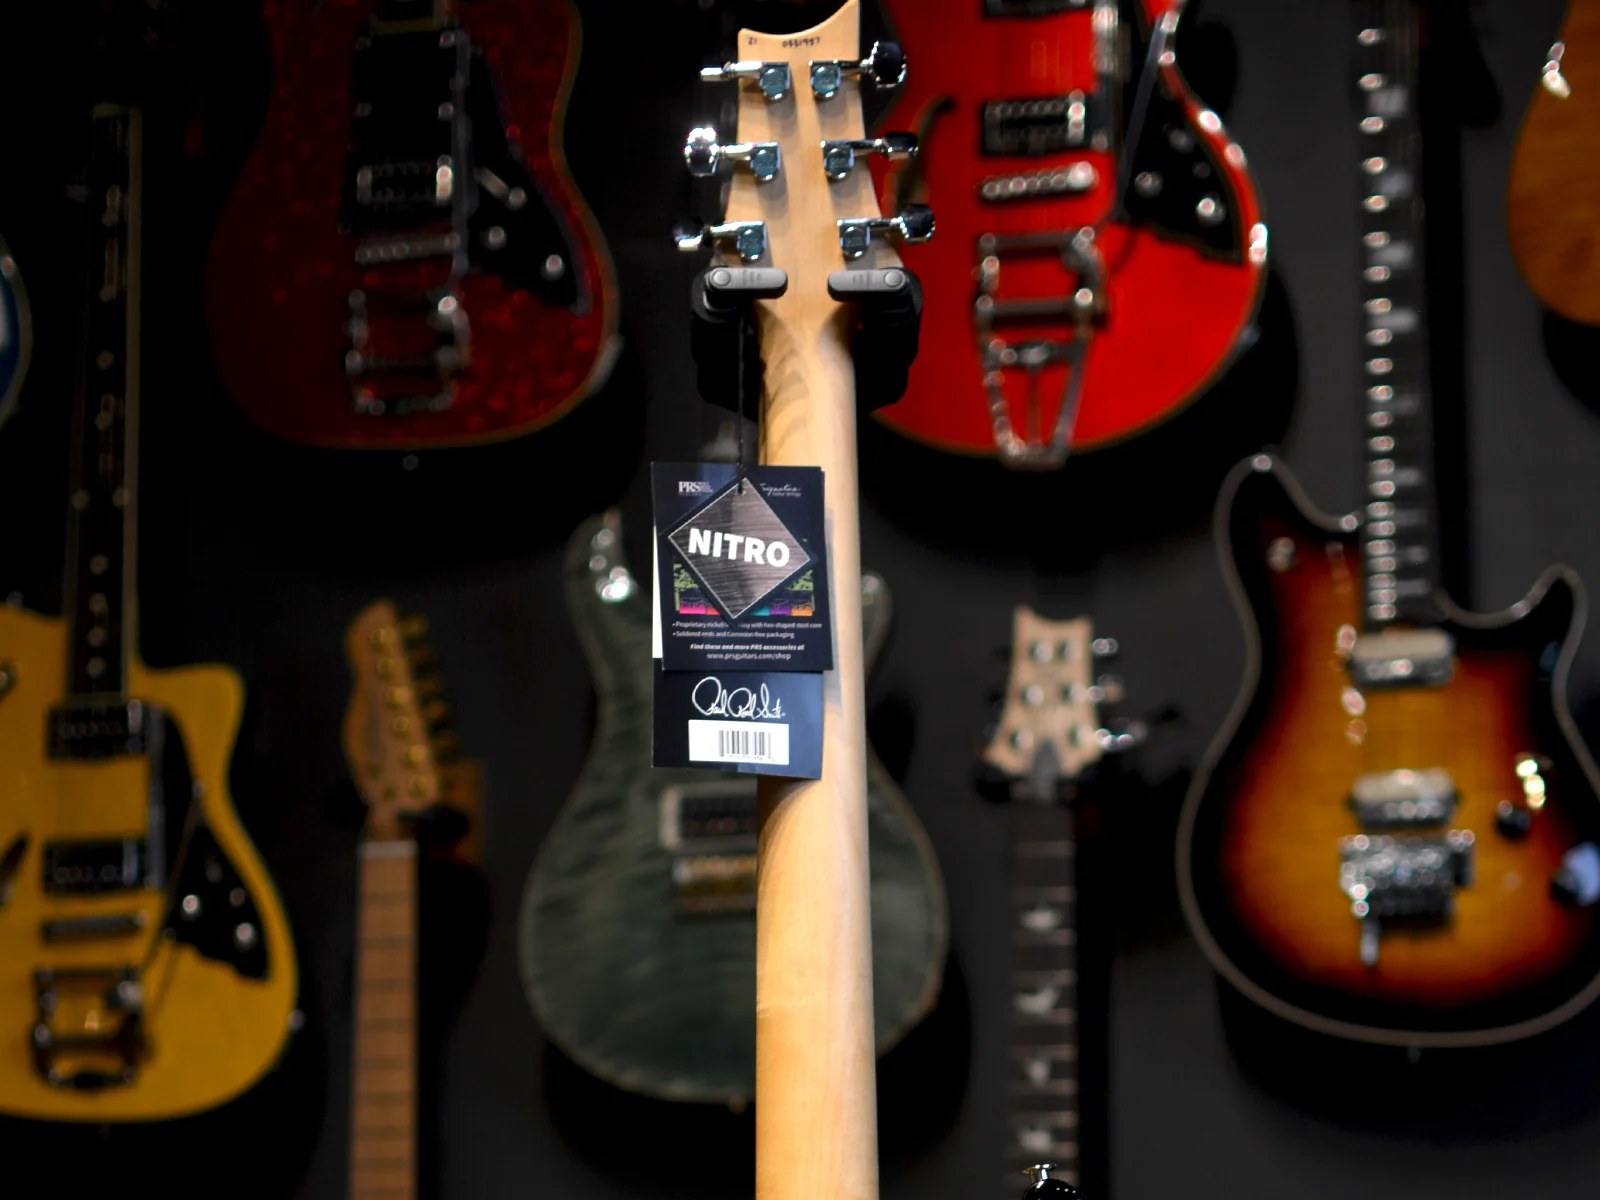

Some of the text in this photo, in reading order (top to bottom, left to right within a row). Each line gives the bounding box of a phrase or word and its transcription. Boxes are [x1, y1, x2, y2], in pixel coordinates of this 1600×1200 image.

[679, 481, 701, 493] PRS
[688, 528, 790, 567] NITRO
[675, 621, 707, 629] Proprietary
